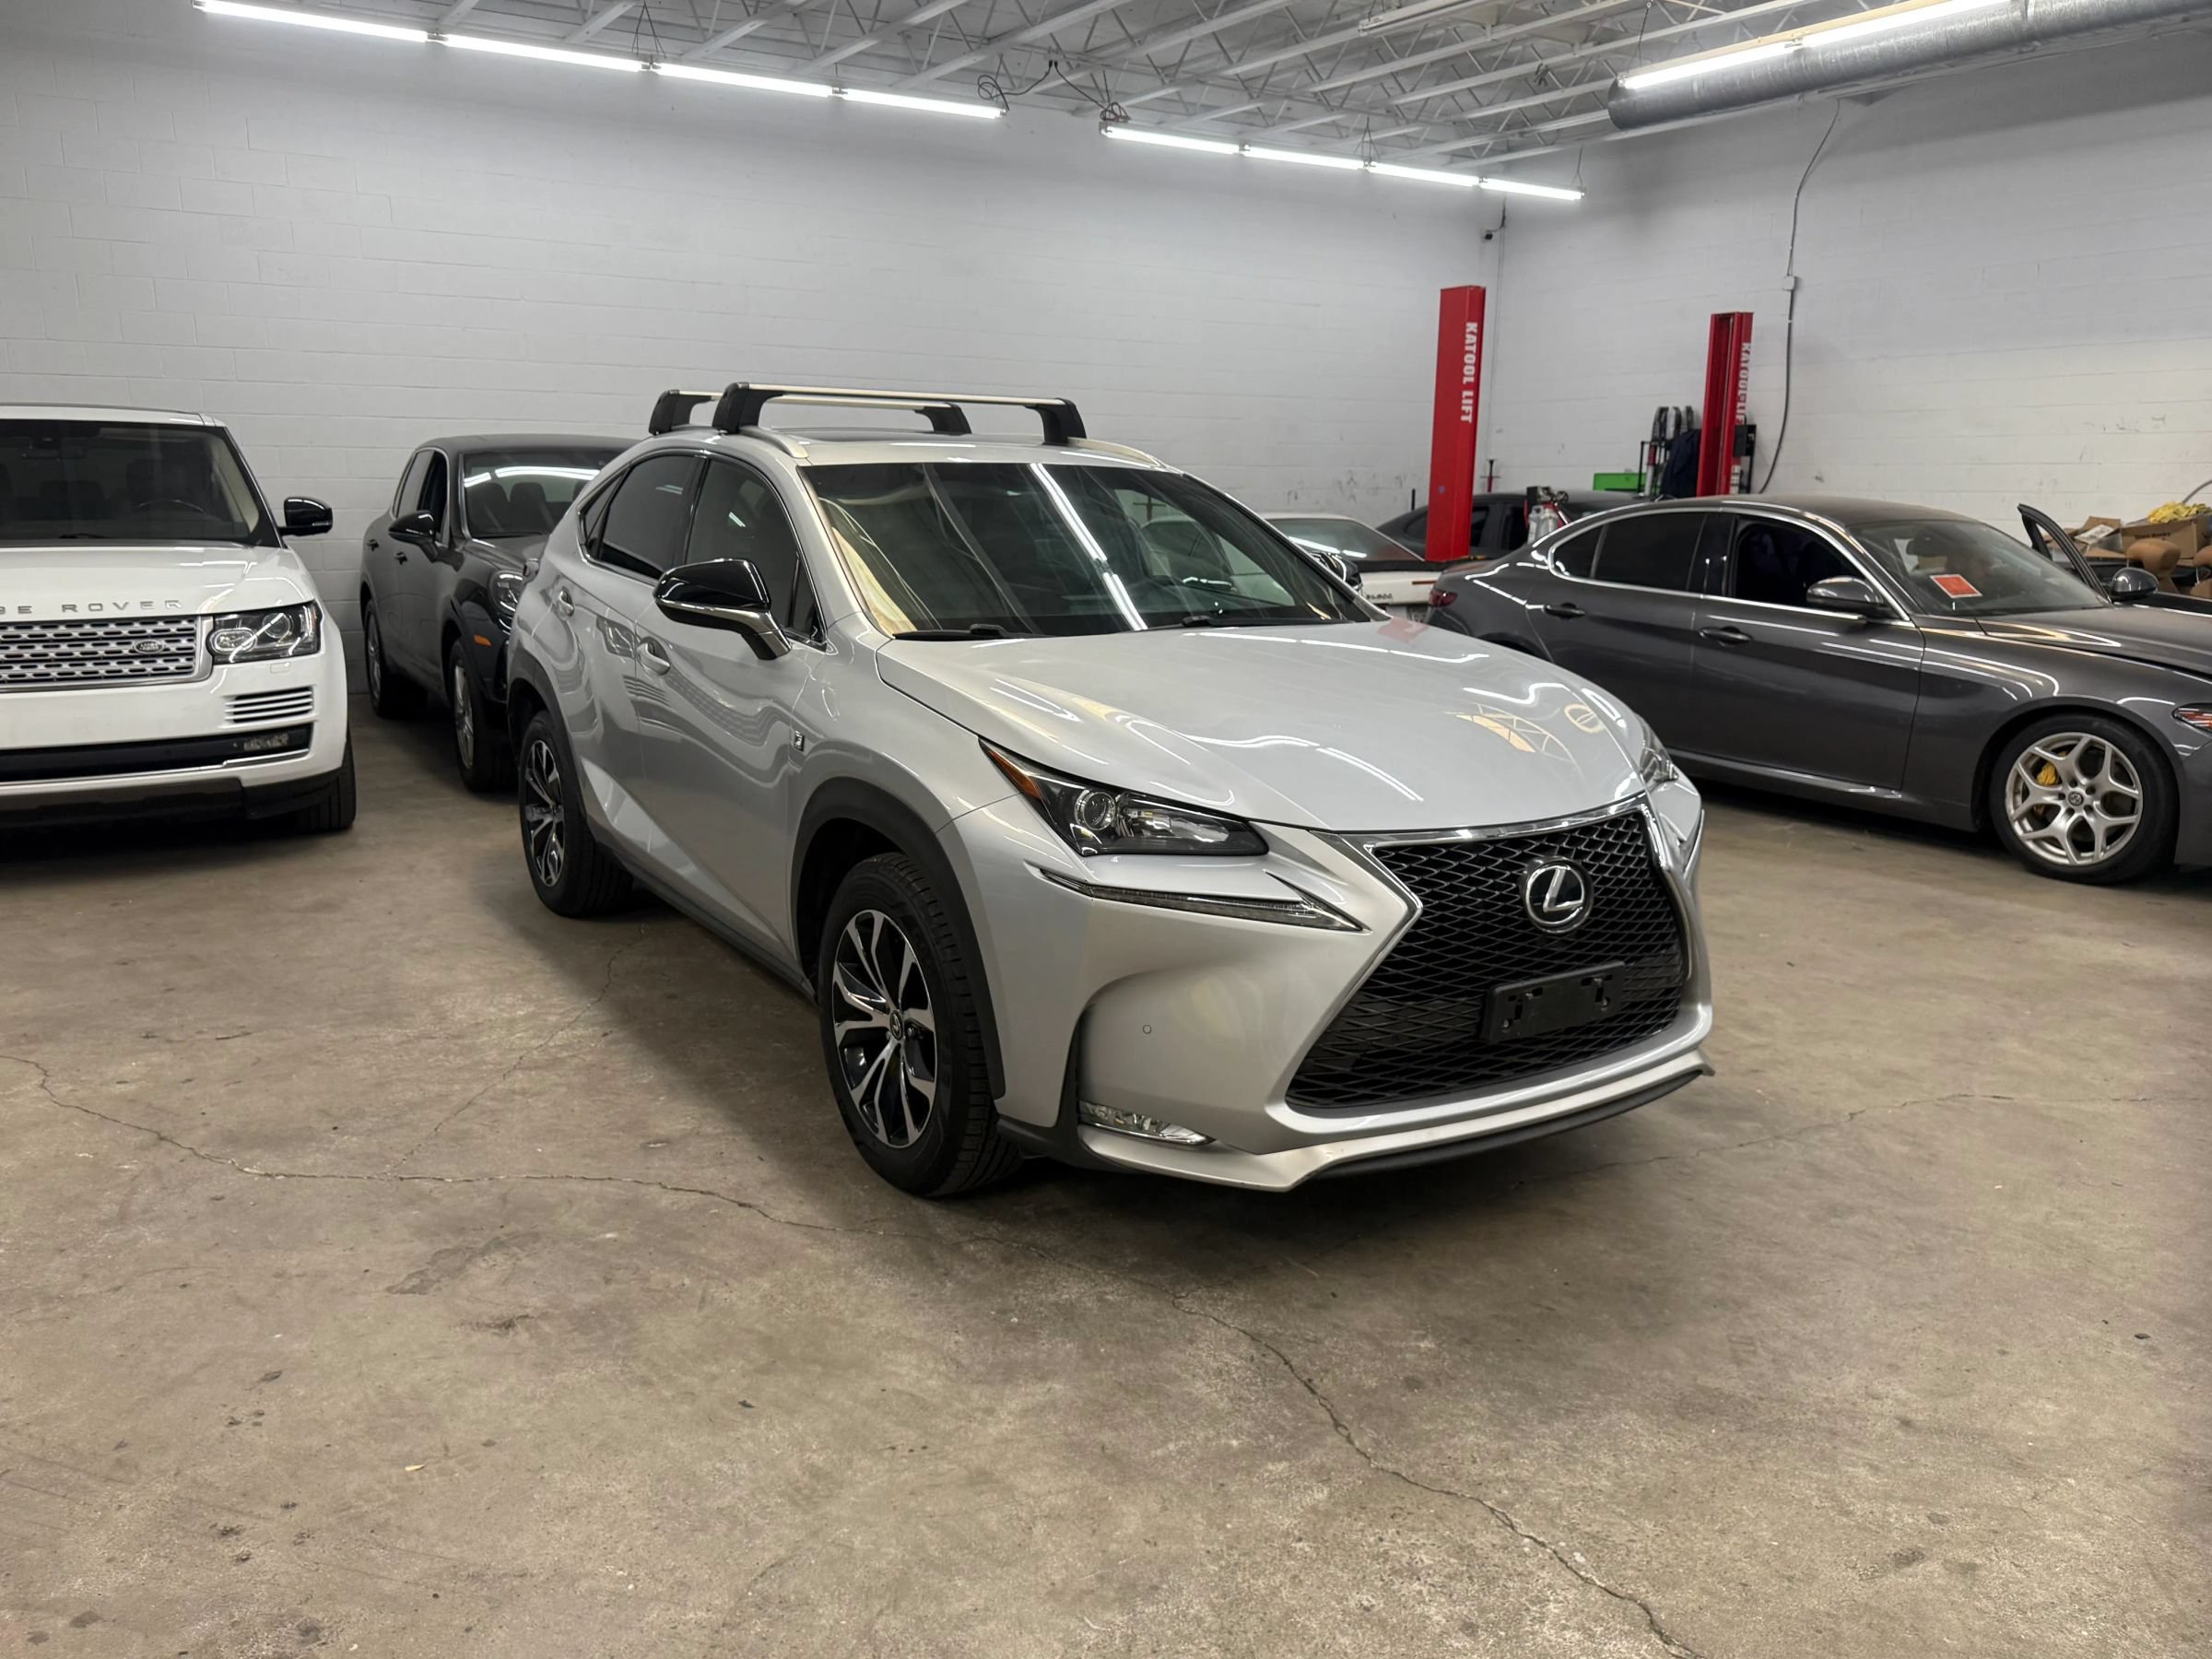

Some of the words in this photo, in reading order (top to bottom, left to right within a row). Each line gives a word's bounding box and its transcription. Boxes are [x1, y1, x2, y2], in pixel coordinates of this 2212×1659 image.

[1463, 322, 1477, 384] KATOOL
[1460, 390, 1474, 424] LIFT
[61, 600, 183, 613] ROVER
